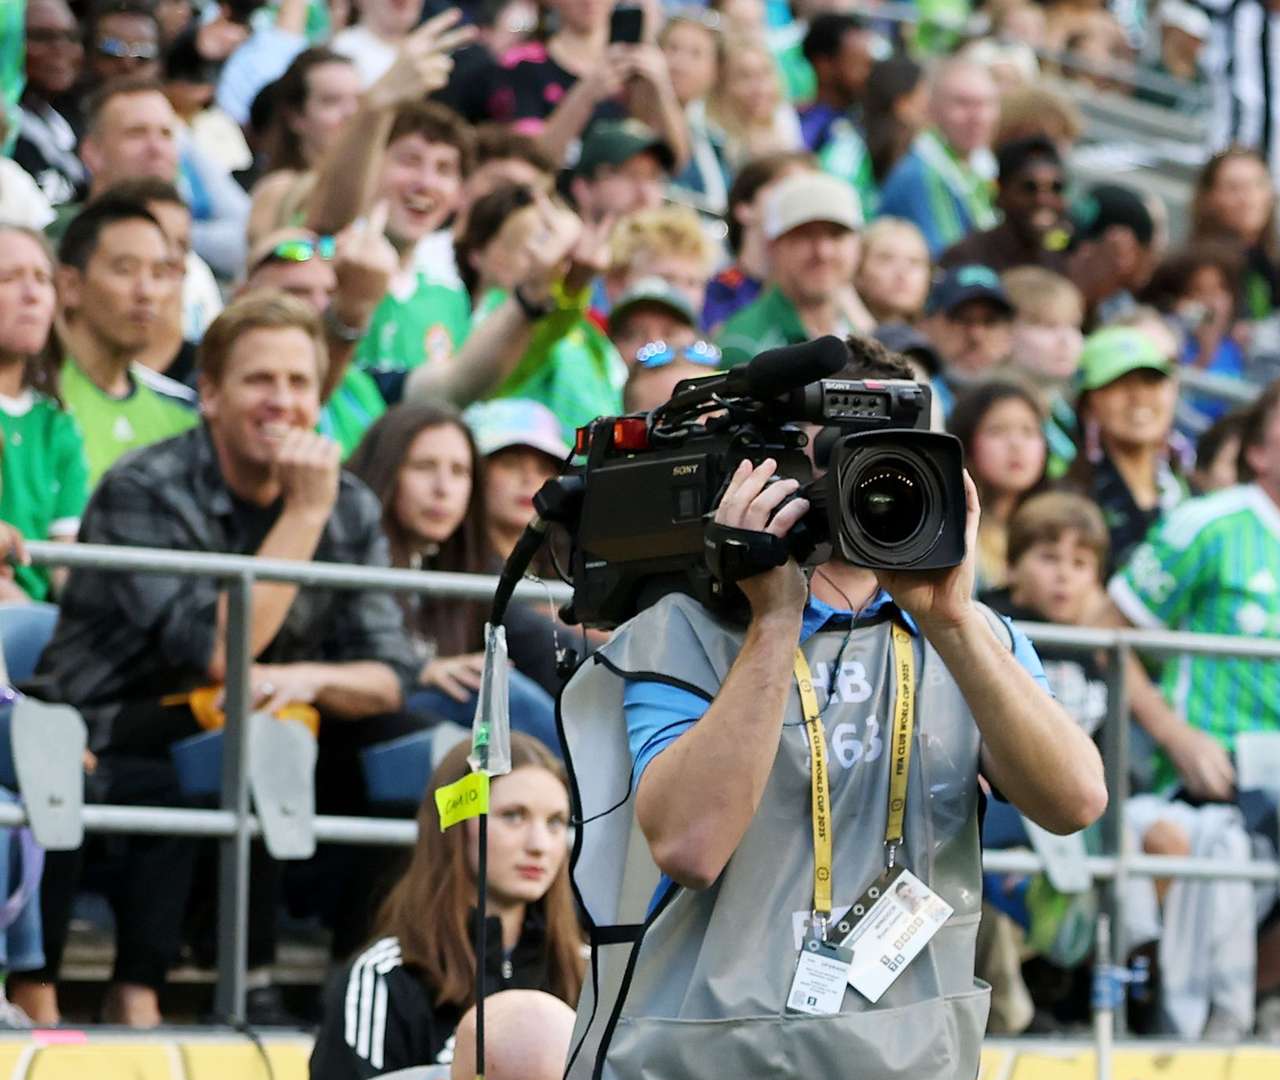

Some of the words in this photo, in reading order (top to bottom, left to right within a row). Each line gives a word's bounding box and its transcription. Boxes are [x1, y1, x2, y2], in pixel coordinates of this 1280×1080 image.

[672, 464, 699, 476] SONY
[899, 702, 910, 731] WORLD
[897, 733, 907, 756] CLUB
[815, 760, 824, 793] WORLD
[816, 796, 825, 814] CUP
